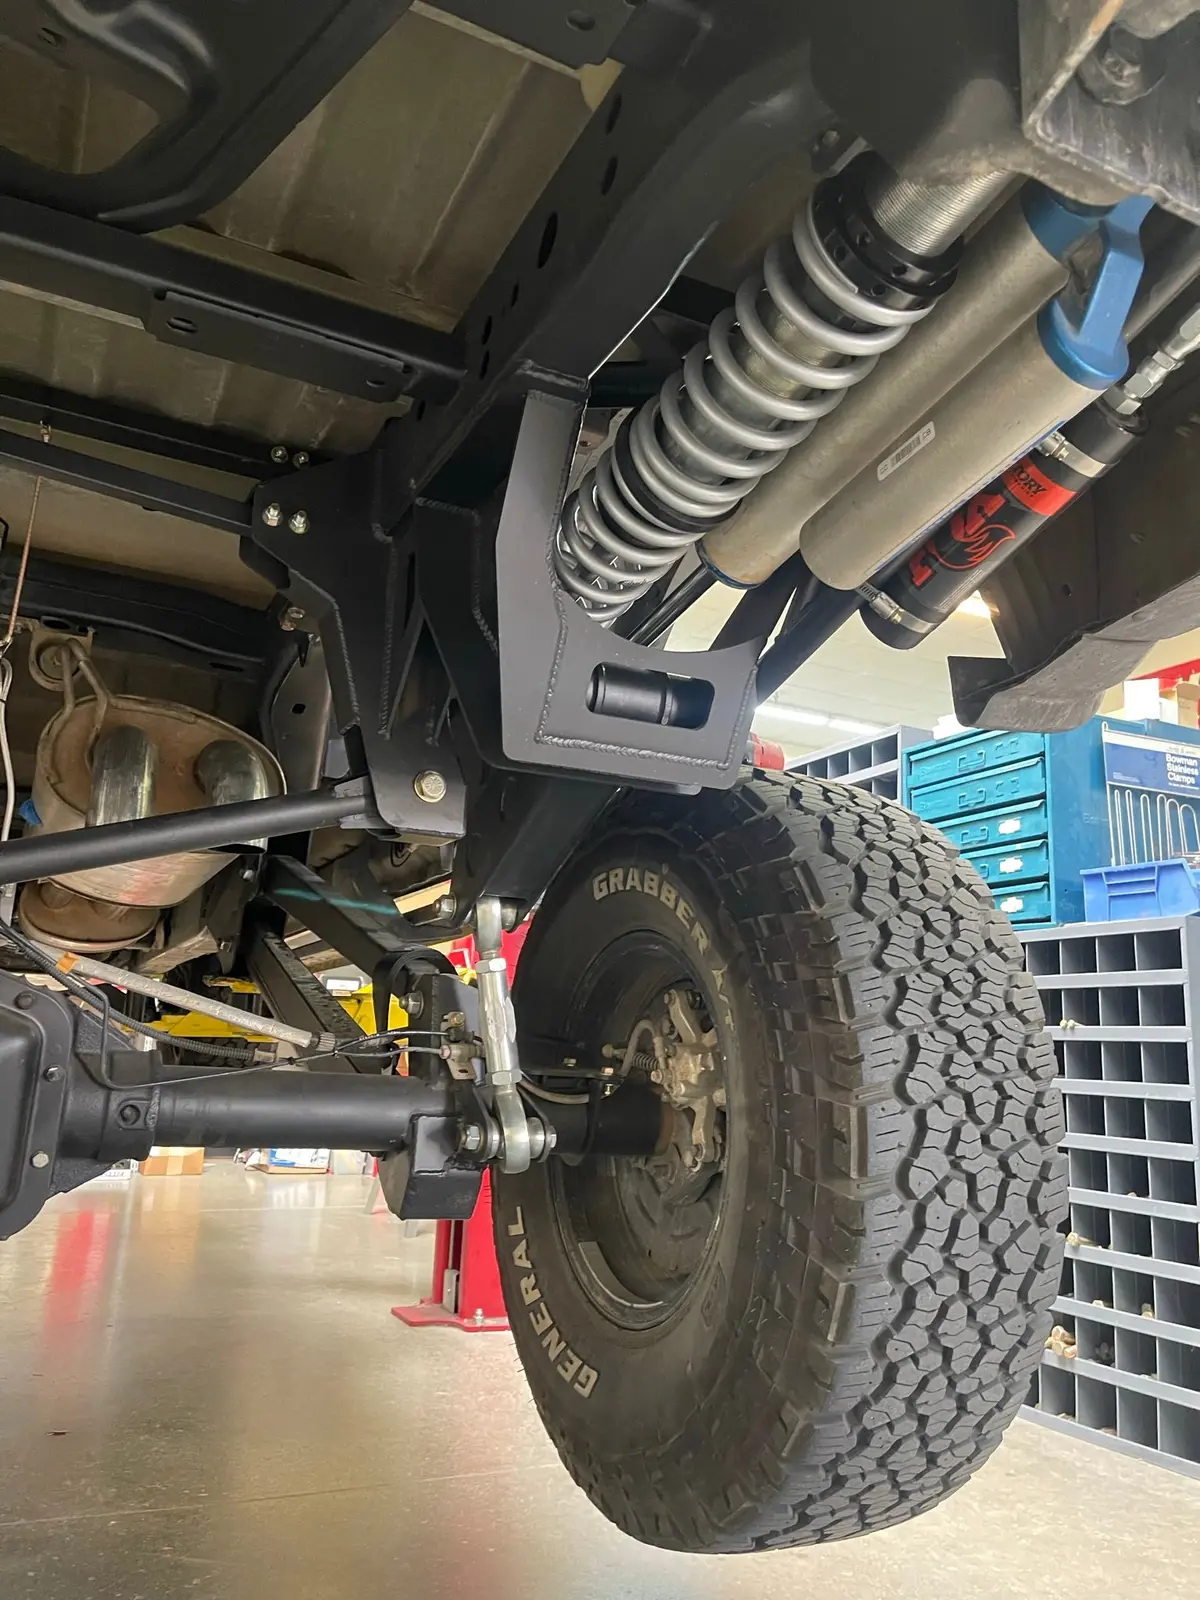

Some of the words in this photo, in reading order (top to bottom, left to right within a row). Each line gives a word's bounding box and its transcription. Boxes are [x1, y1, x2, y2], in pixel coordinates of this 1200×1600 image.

[1165, 753, 1198, 767] Bowman
[1166, 762, 1199, 776] Stainless
[1167, 772, 1196, 785] Clamps
[592, 867, 711, 957] GRABBER
[507, 1205, 599, 1399] GENERAL
